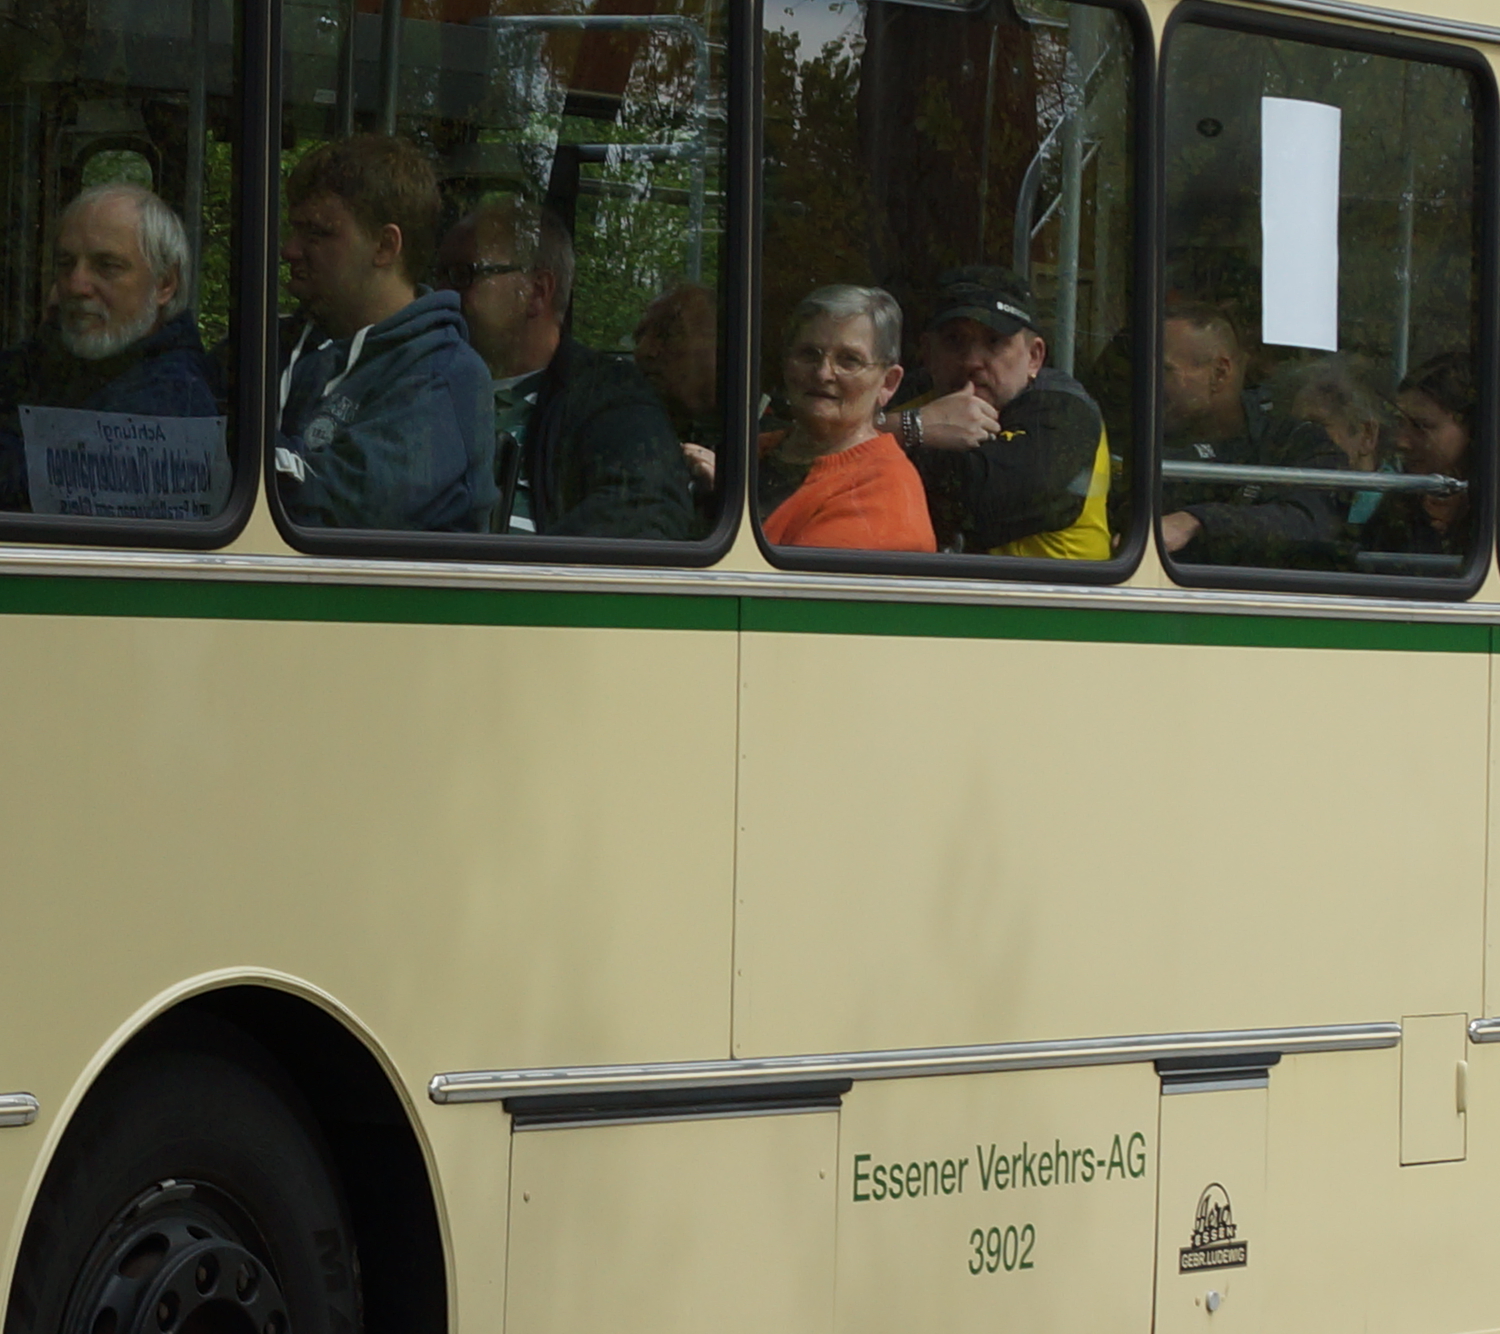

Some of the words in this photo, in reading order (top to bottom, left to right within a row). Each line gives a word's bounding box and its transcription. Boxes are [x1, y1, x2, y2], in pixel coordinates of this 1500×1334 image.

[852, 1152, 970, 1203] Essener
[975, 1130, 1148, 1193] Verkehrs-AG
[968, 1223, 1036, 1276] 3902
